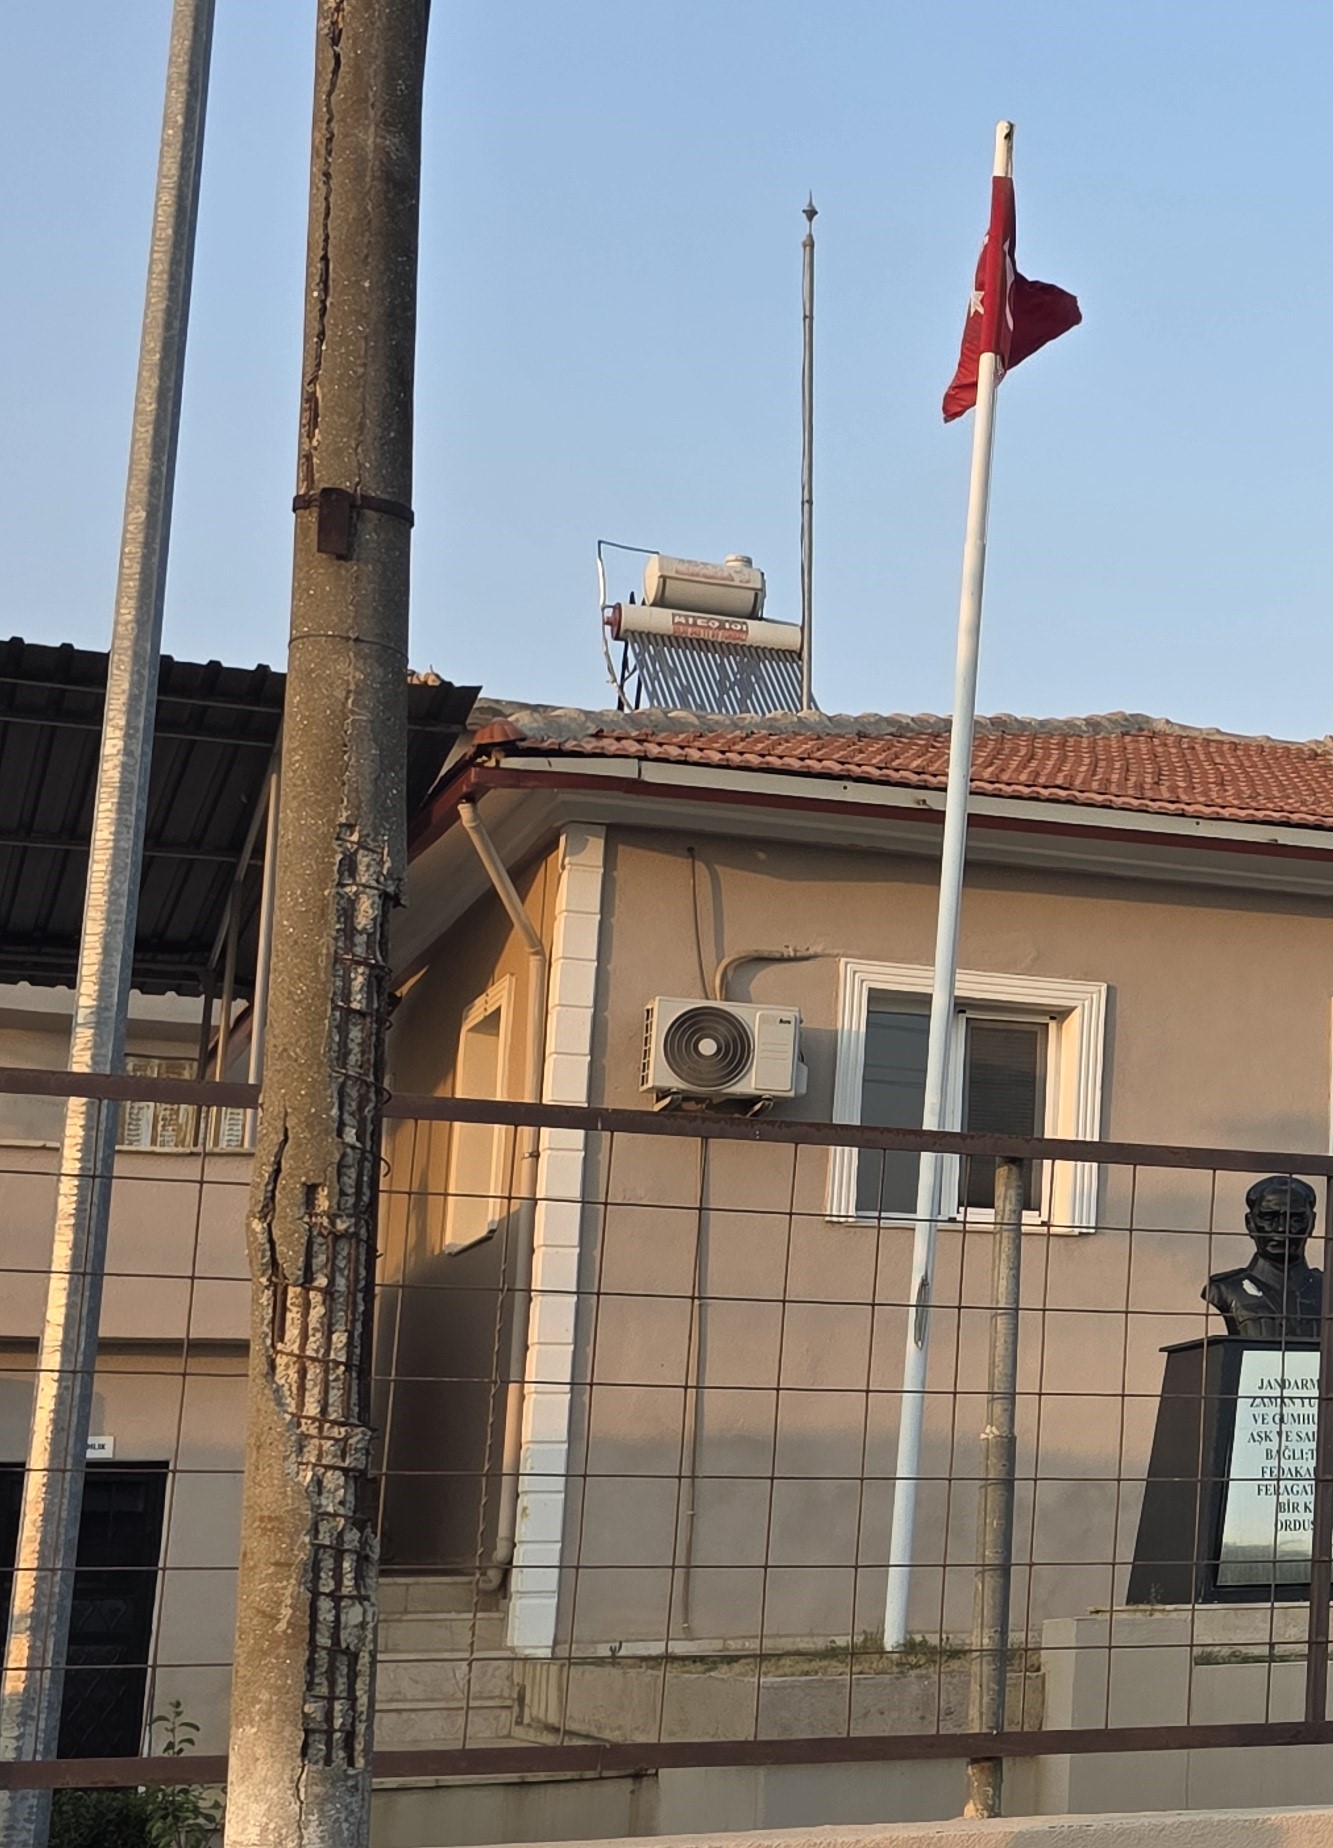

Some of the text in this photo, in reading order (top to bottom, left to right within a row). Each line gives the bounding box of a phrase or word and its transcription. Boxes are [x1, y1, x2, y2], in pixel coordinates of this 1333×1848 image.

[1258, 1378, 1323, 1391] JANDARM
[1252, 1414, 1269, 1426] VE
[1248, 1430, 1273, 1446] AŞK
[1278, 1498, 1300, 1513] BİR
